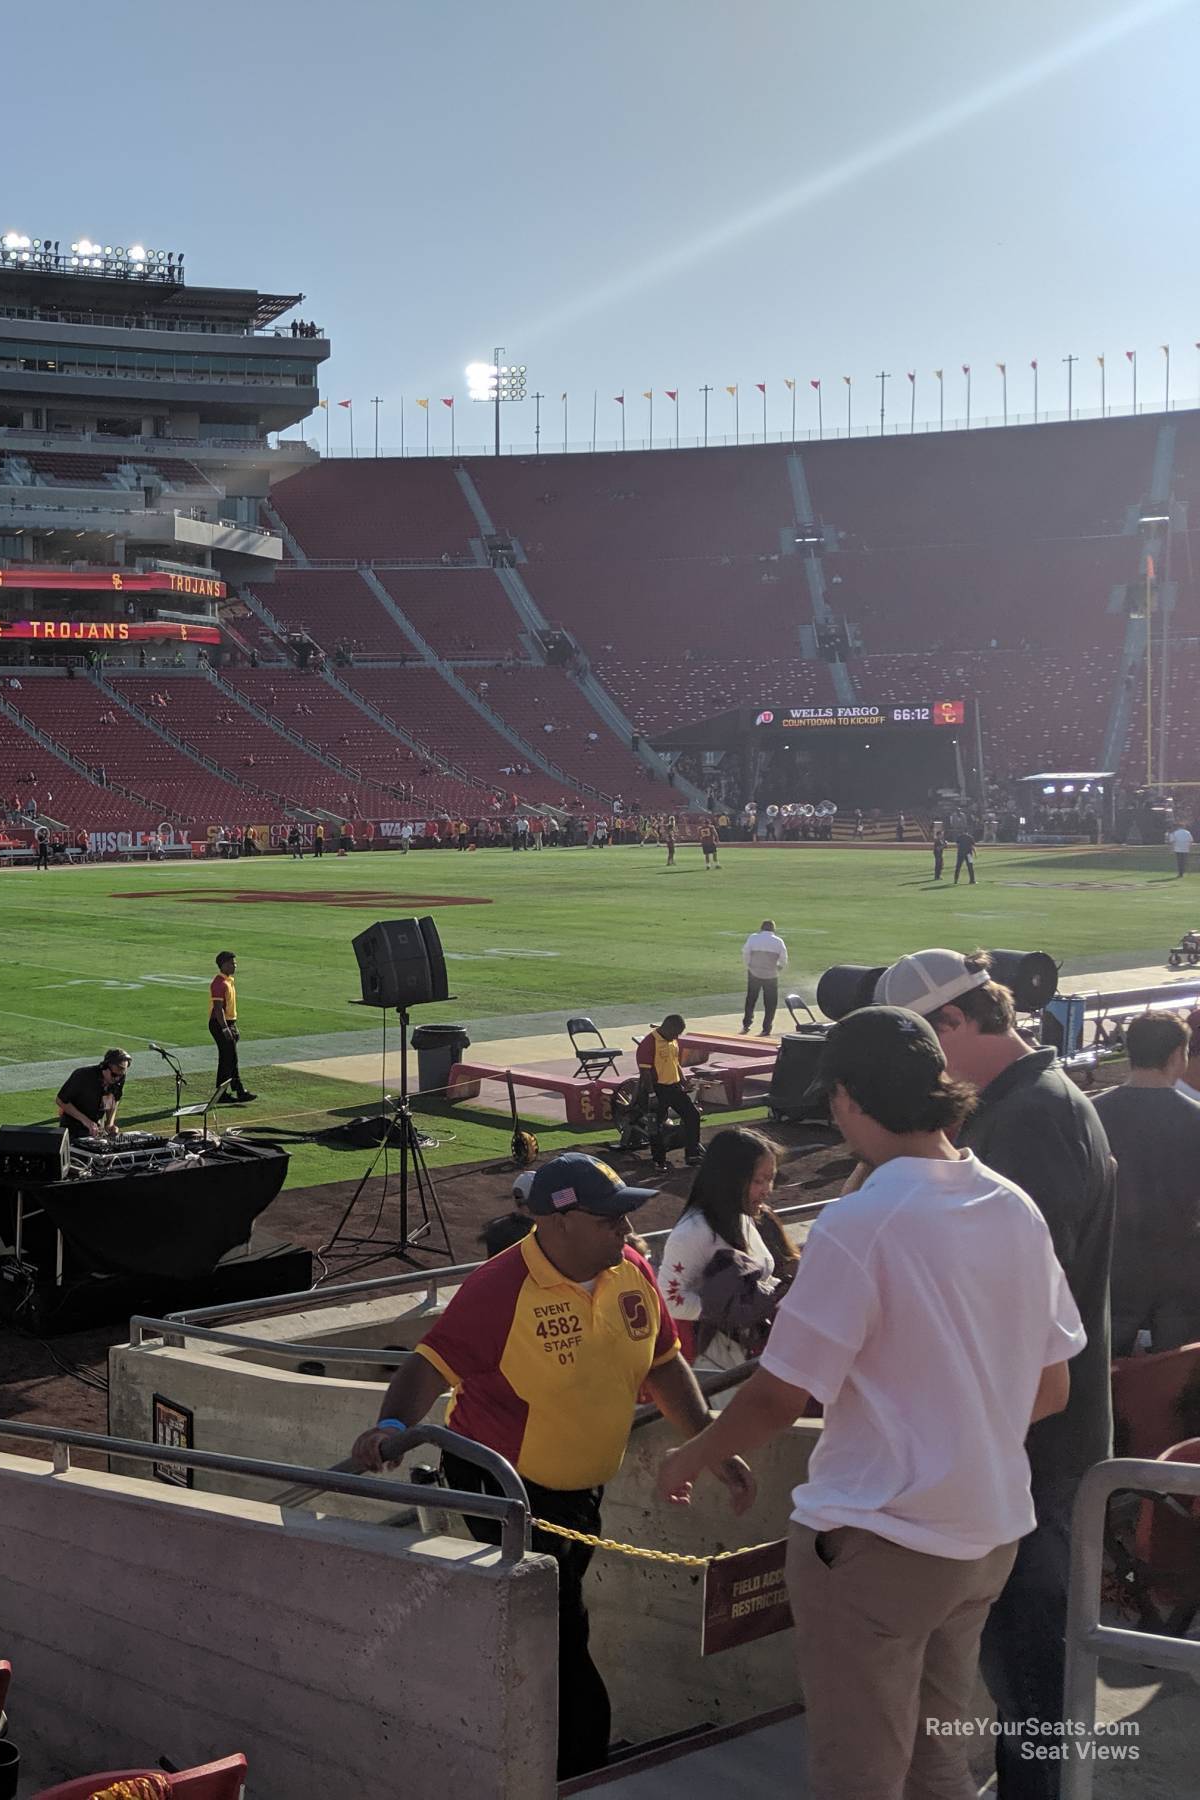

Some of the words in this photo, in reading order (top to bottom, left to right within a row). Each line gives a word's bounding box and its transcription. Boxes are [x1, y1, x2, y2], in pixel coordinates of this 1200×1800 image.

[169, 574, 221, 597] TROJANS
[30, 621, 130, 640] TROJANS
[790, 708, 833, 718] WELLS
[837, 707, 879, 717] FARGO
[893, 708, 930, 720] 66:12
[782, 718, 836, 727] COUNTDOWN
[837, 718, 849, 726] TO
[850, 716, 887, 726] KICKOFF
[534, 1302, 572, 1318] EVENT
[535, 1315, 583, 1339] 4582
[543, 1335, 583, 1353] STAFF
[558, 1352, 575, 1365] 01
[733, 1576, 761, 1597] FIELD
